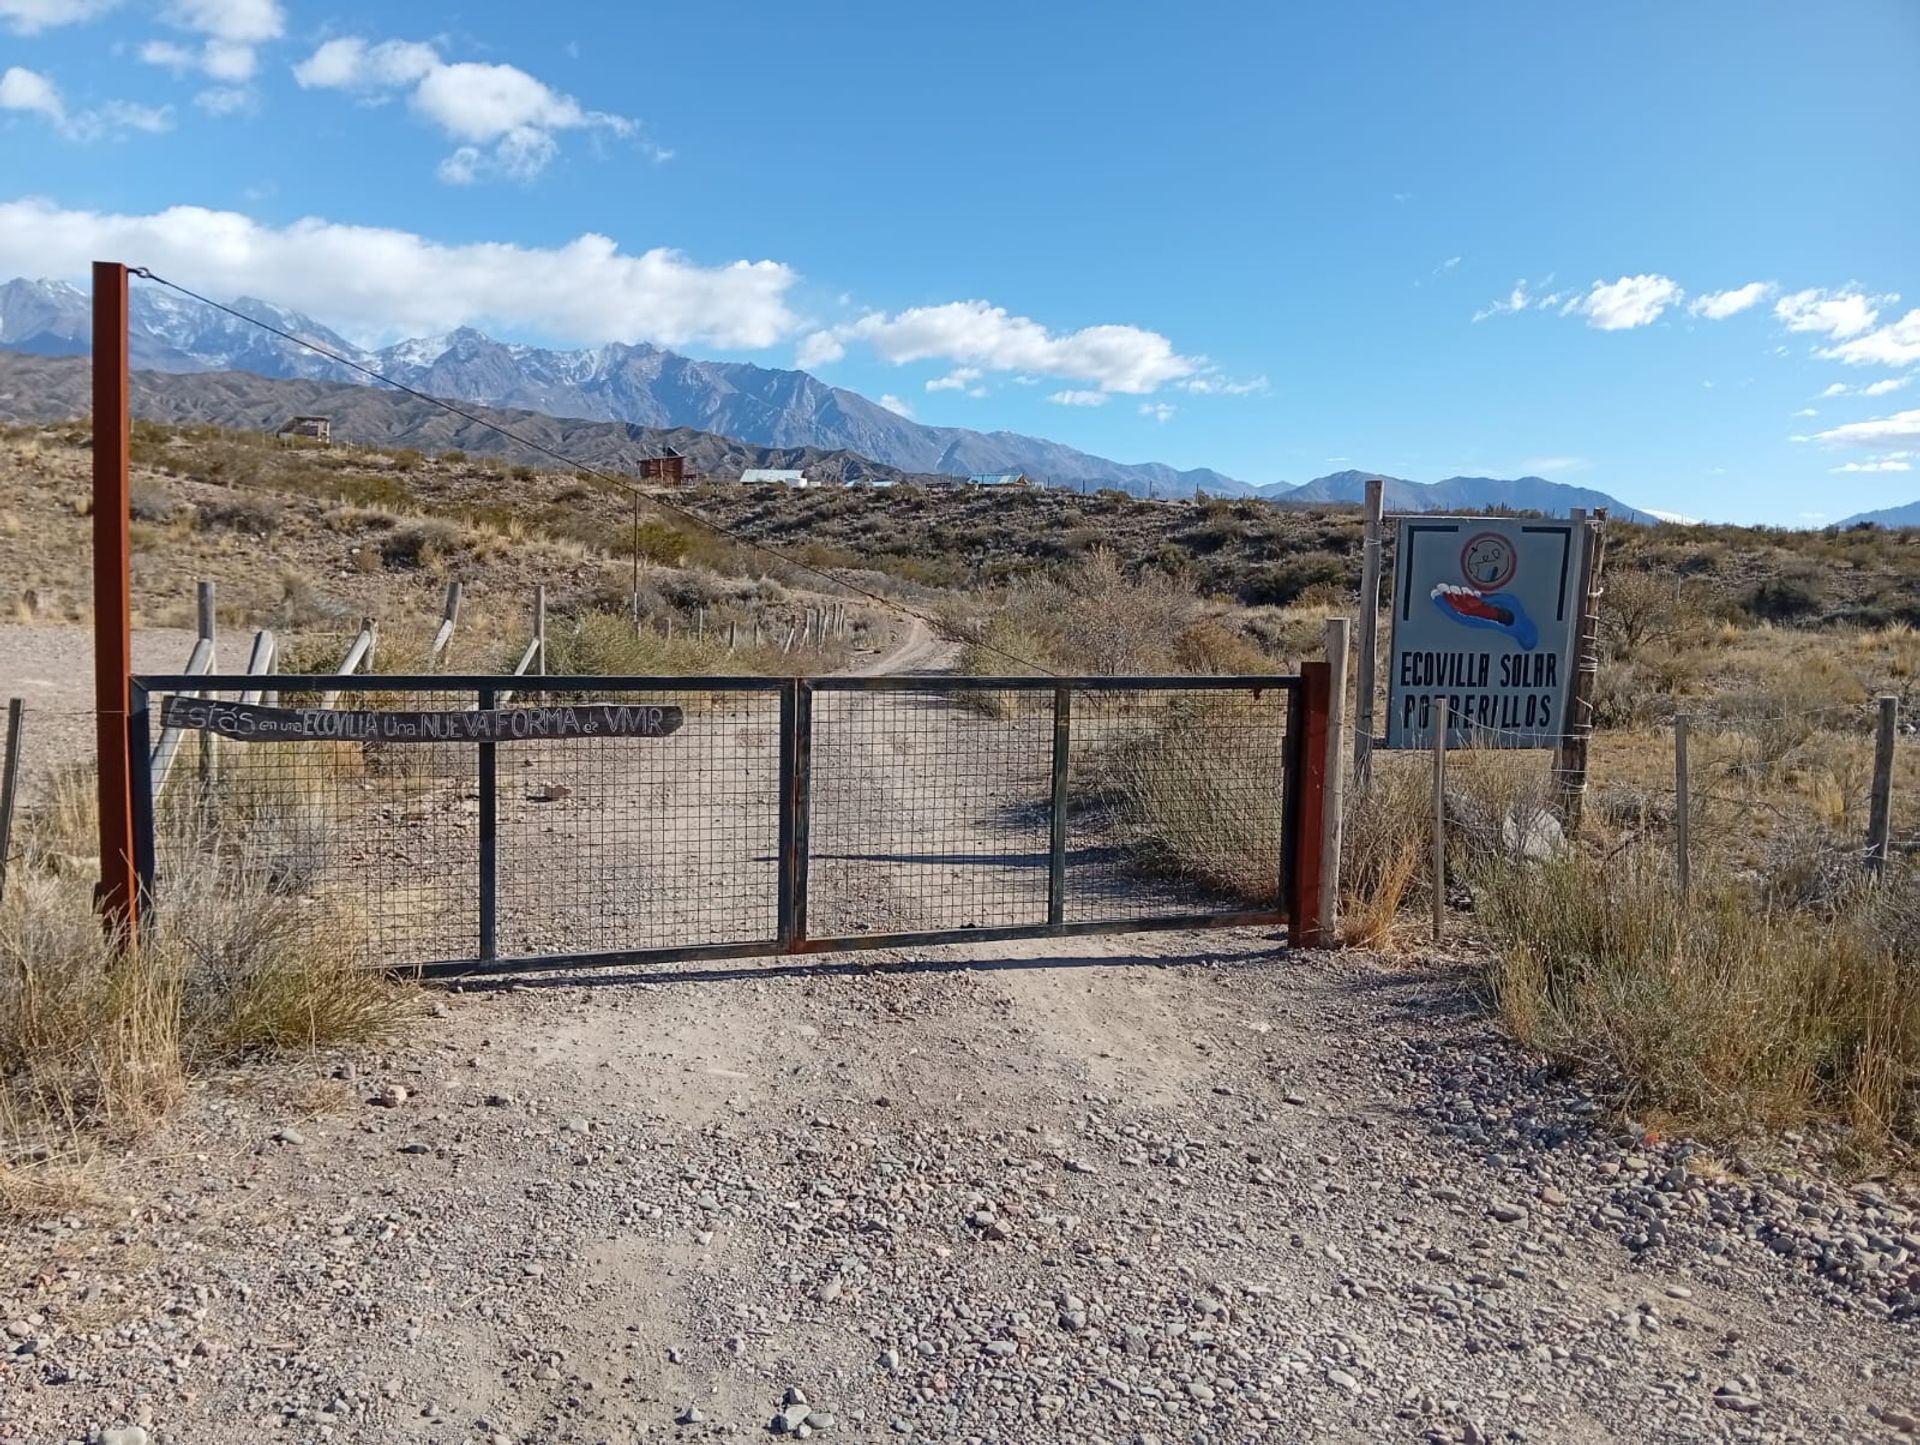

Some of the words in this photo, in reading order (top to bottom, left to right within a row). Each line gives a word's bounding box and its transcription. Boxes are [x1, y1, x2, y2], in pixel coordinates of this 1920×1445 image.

[1400, 651, 1490, 688] ECOVILLA
[1500, 652, 1557, 688] SOLAR
[166, 697, 256, 736] Estás
[258, 720, 277, 732] en
[280, 721, 302, 733] una
[421, 713, 491, 739] NUEVA
[496, 707, 579, 737] FORMA
[604, 706, 664, 736] VIVIR
